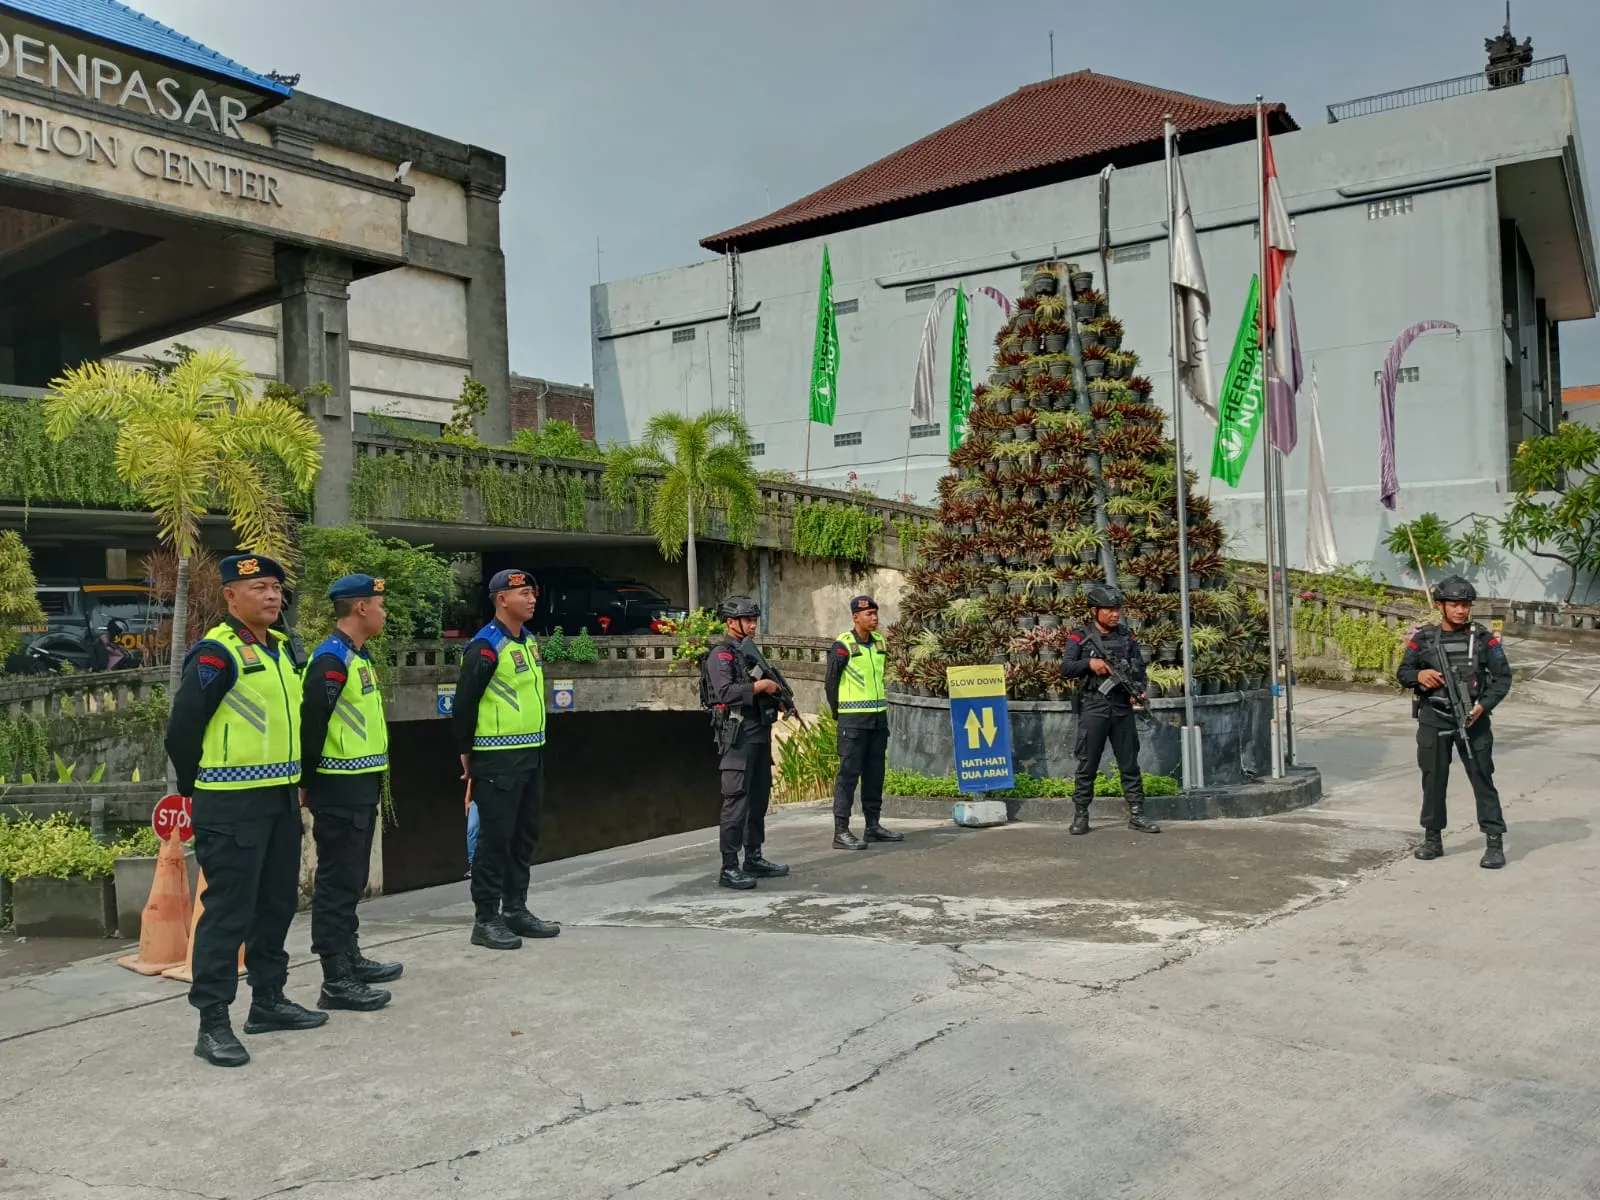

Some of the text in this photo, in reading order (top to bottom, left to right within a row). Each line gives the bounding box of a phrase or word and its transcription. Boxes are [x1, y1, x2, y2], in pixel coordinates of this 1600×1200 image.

[0, 108, 283, 207] TION CENTER
[950, 677, 1003, 687] SLOW DOWN
[961, 756, 1007, 769] HATI-HATI
[961, 768, 1009, 780] DUA ARAH
